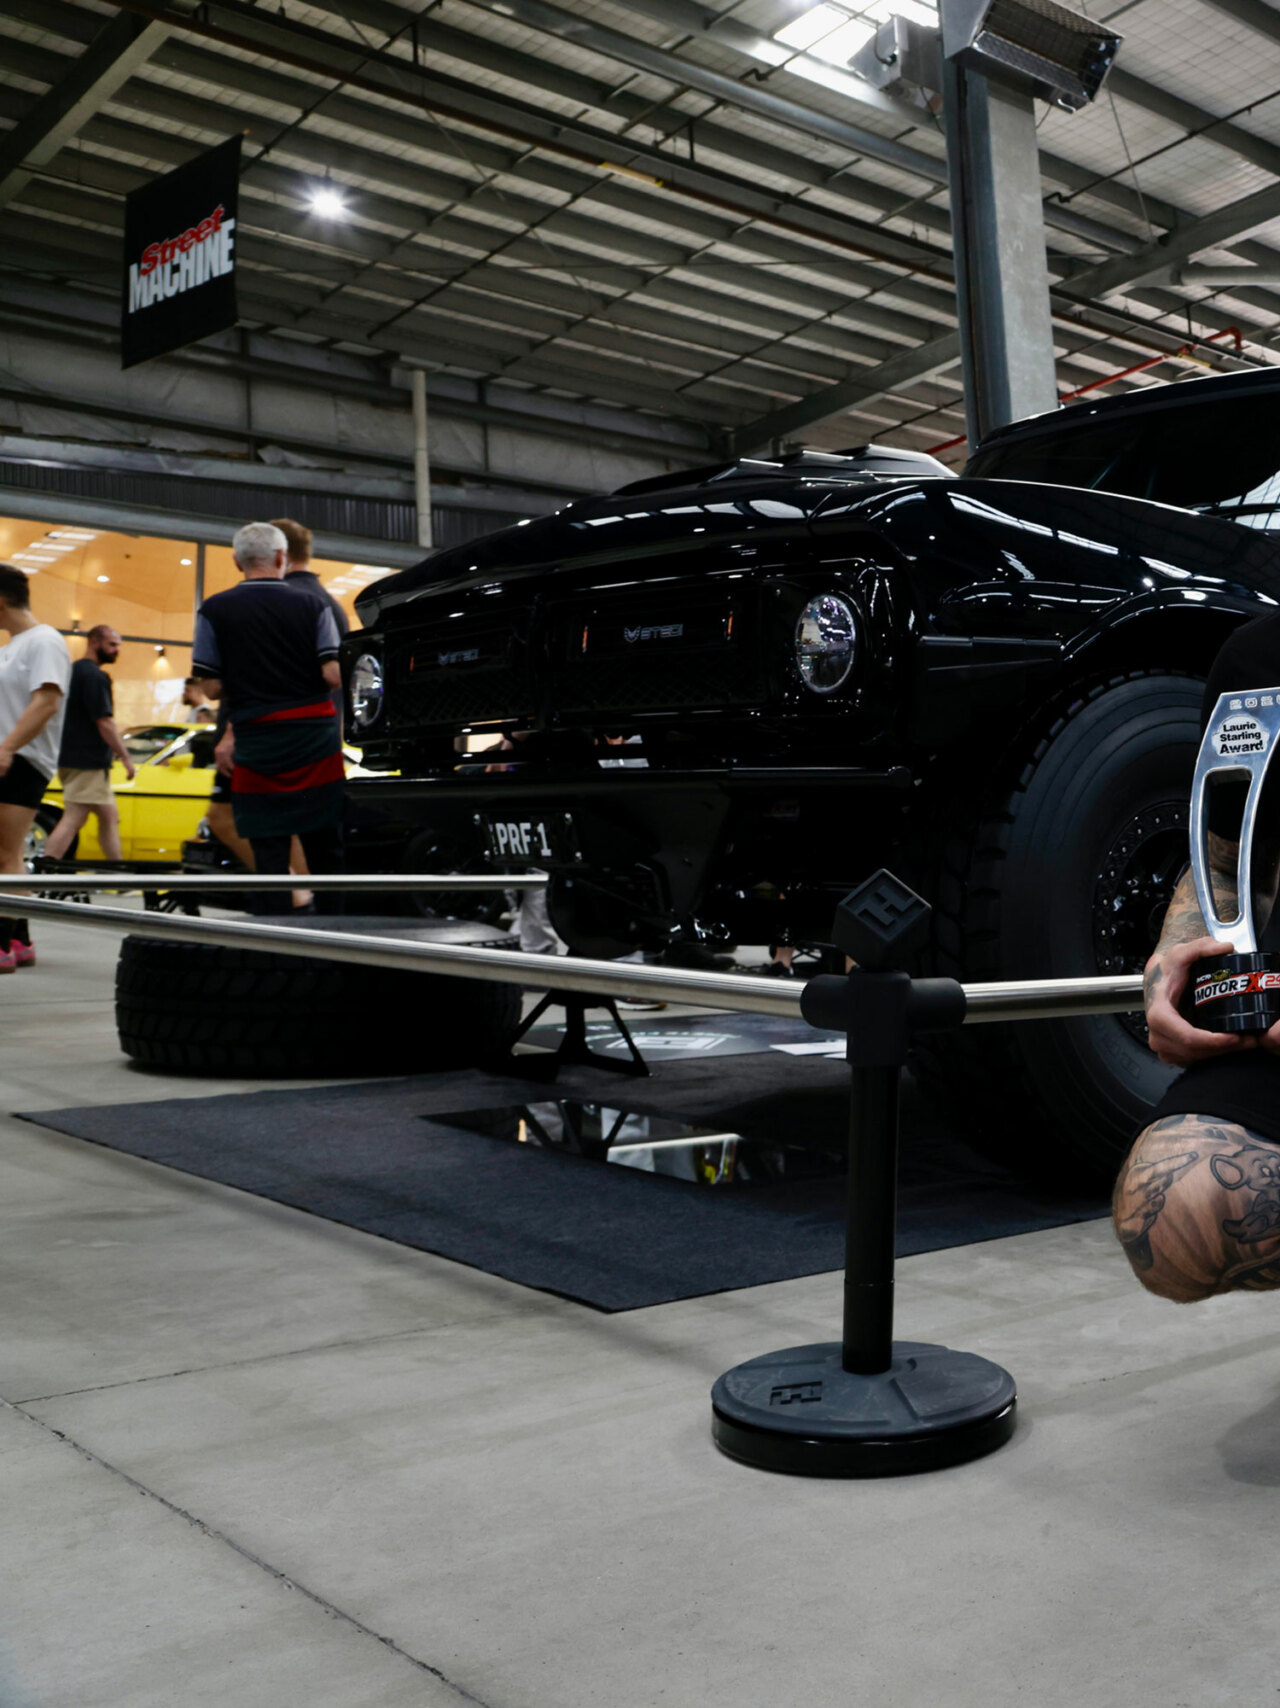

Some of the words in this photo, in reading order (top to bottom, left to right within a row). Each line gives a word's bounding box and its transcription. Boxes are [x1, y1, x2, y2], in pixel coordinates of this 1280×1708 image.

[139, 204, 225, 276] Street
[128, 218, 236, 314] MACHINE
[1223, 722, 1257, 732] Laurie
[1220, 731, 1261, 743] Starling
[1219, 740, 1263, 754] Award
